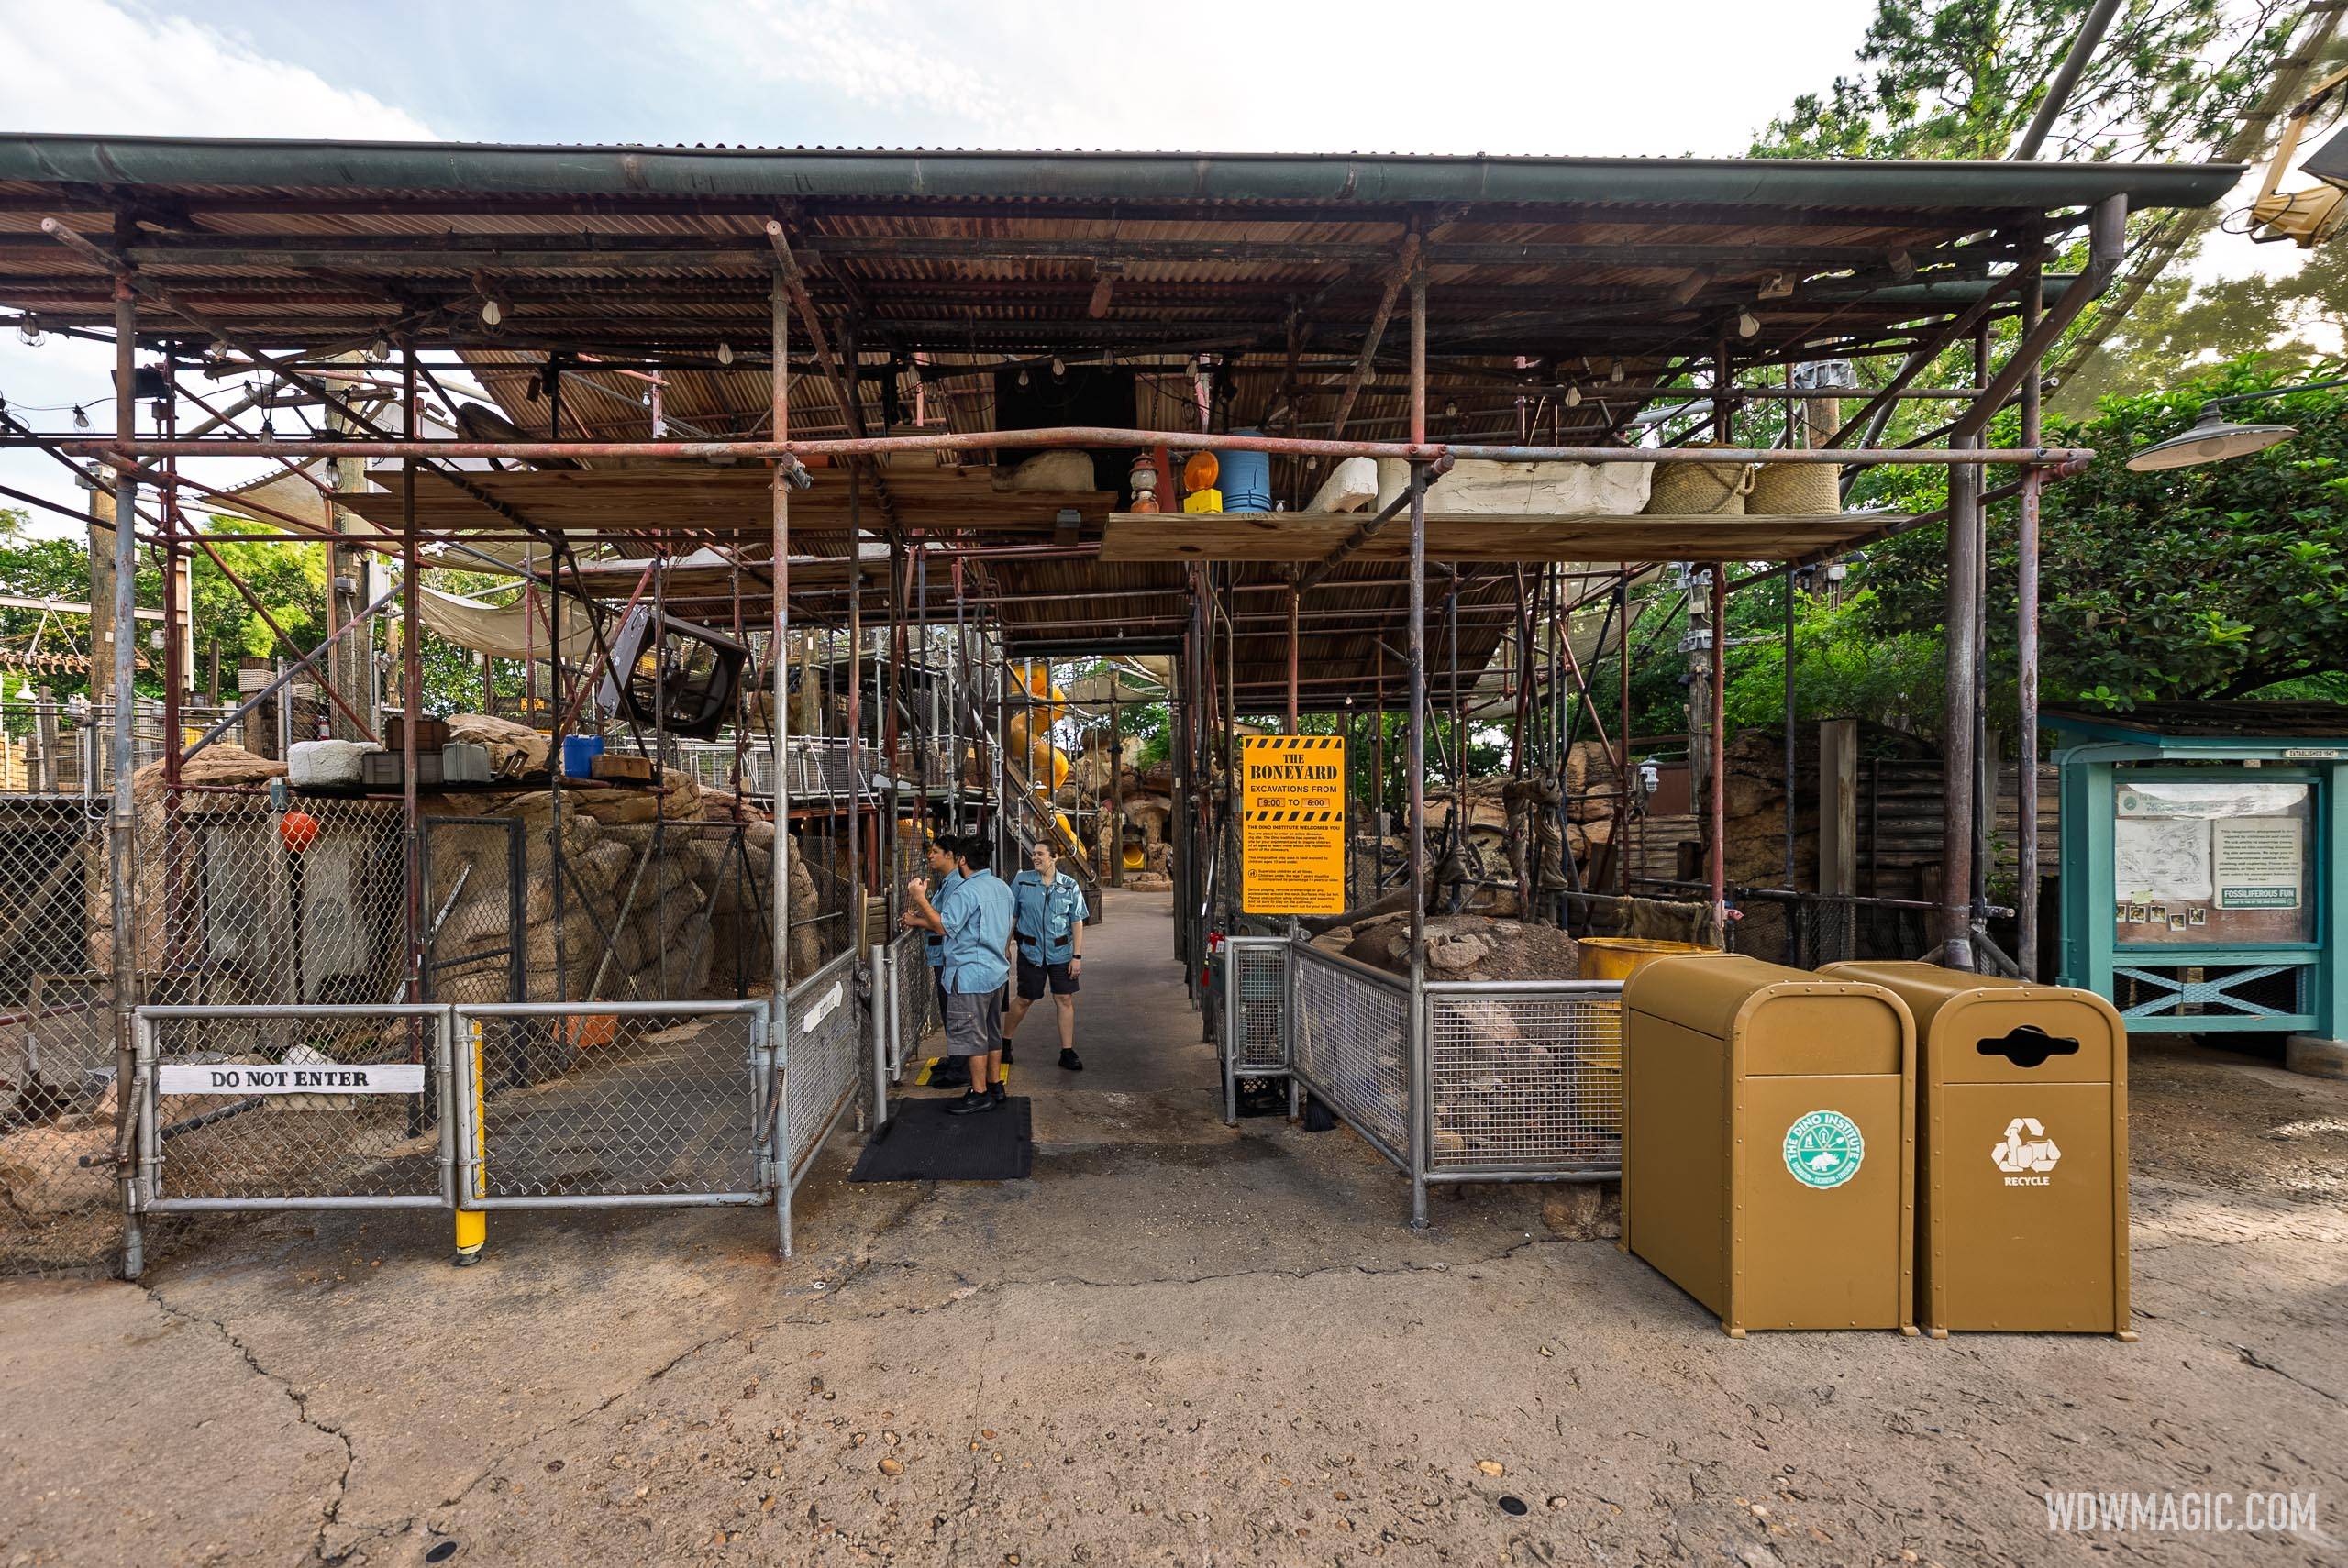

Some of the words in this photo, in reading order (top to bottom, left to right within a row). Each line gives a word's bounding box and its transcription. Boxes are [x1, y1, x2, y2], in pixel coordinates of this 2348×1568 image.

[1283, 754, 1305, 763] THE
[1250, 765, 1338, 780] BONEYARD
[2224, 889, 2278, 898] FOSSILIFEROUS
[2279, 889, 2295, 898] FUN
[211, 1071, 240, 1088] DO
[246, 1070, 288, 1087] NOT
[294, 1070, 370, 1087] ENTER
[1792, 1115, 1822, 1137] DINO
[1824, 1113, 1861, 1160] INSTITUTE
[1787, 1138, 1799, 1162] THE
[2004, 1176, 2051, 1187] RECYCLE
